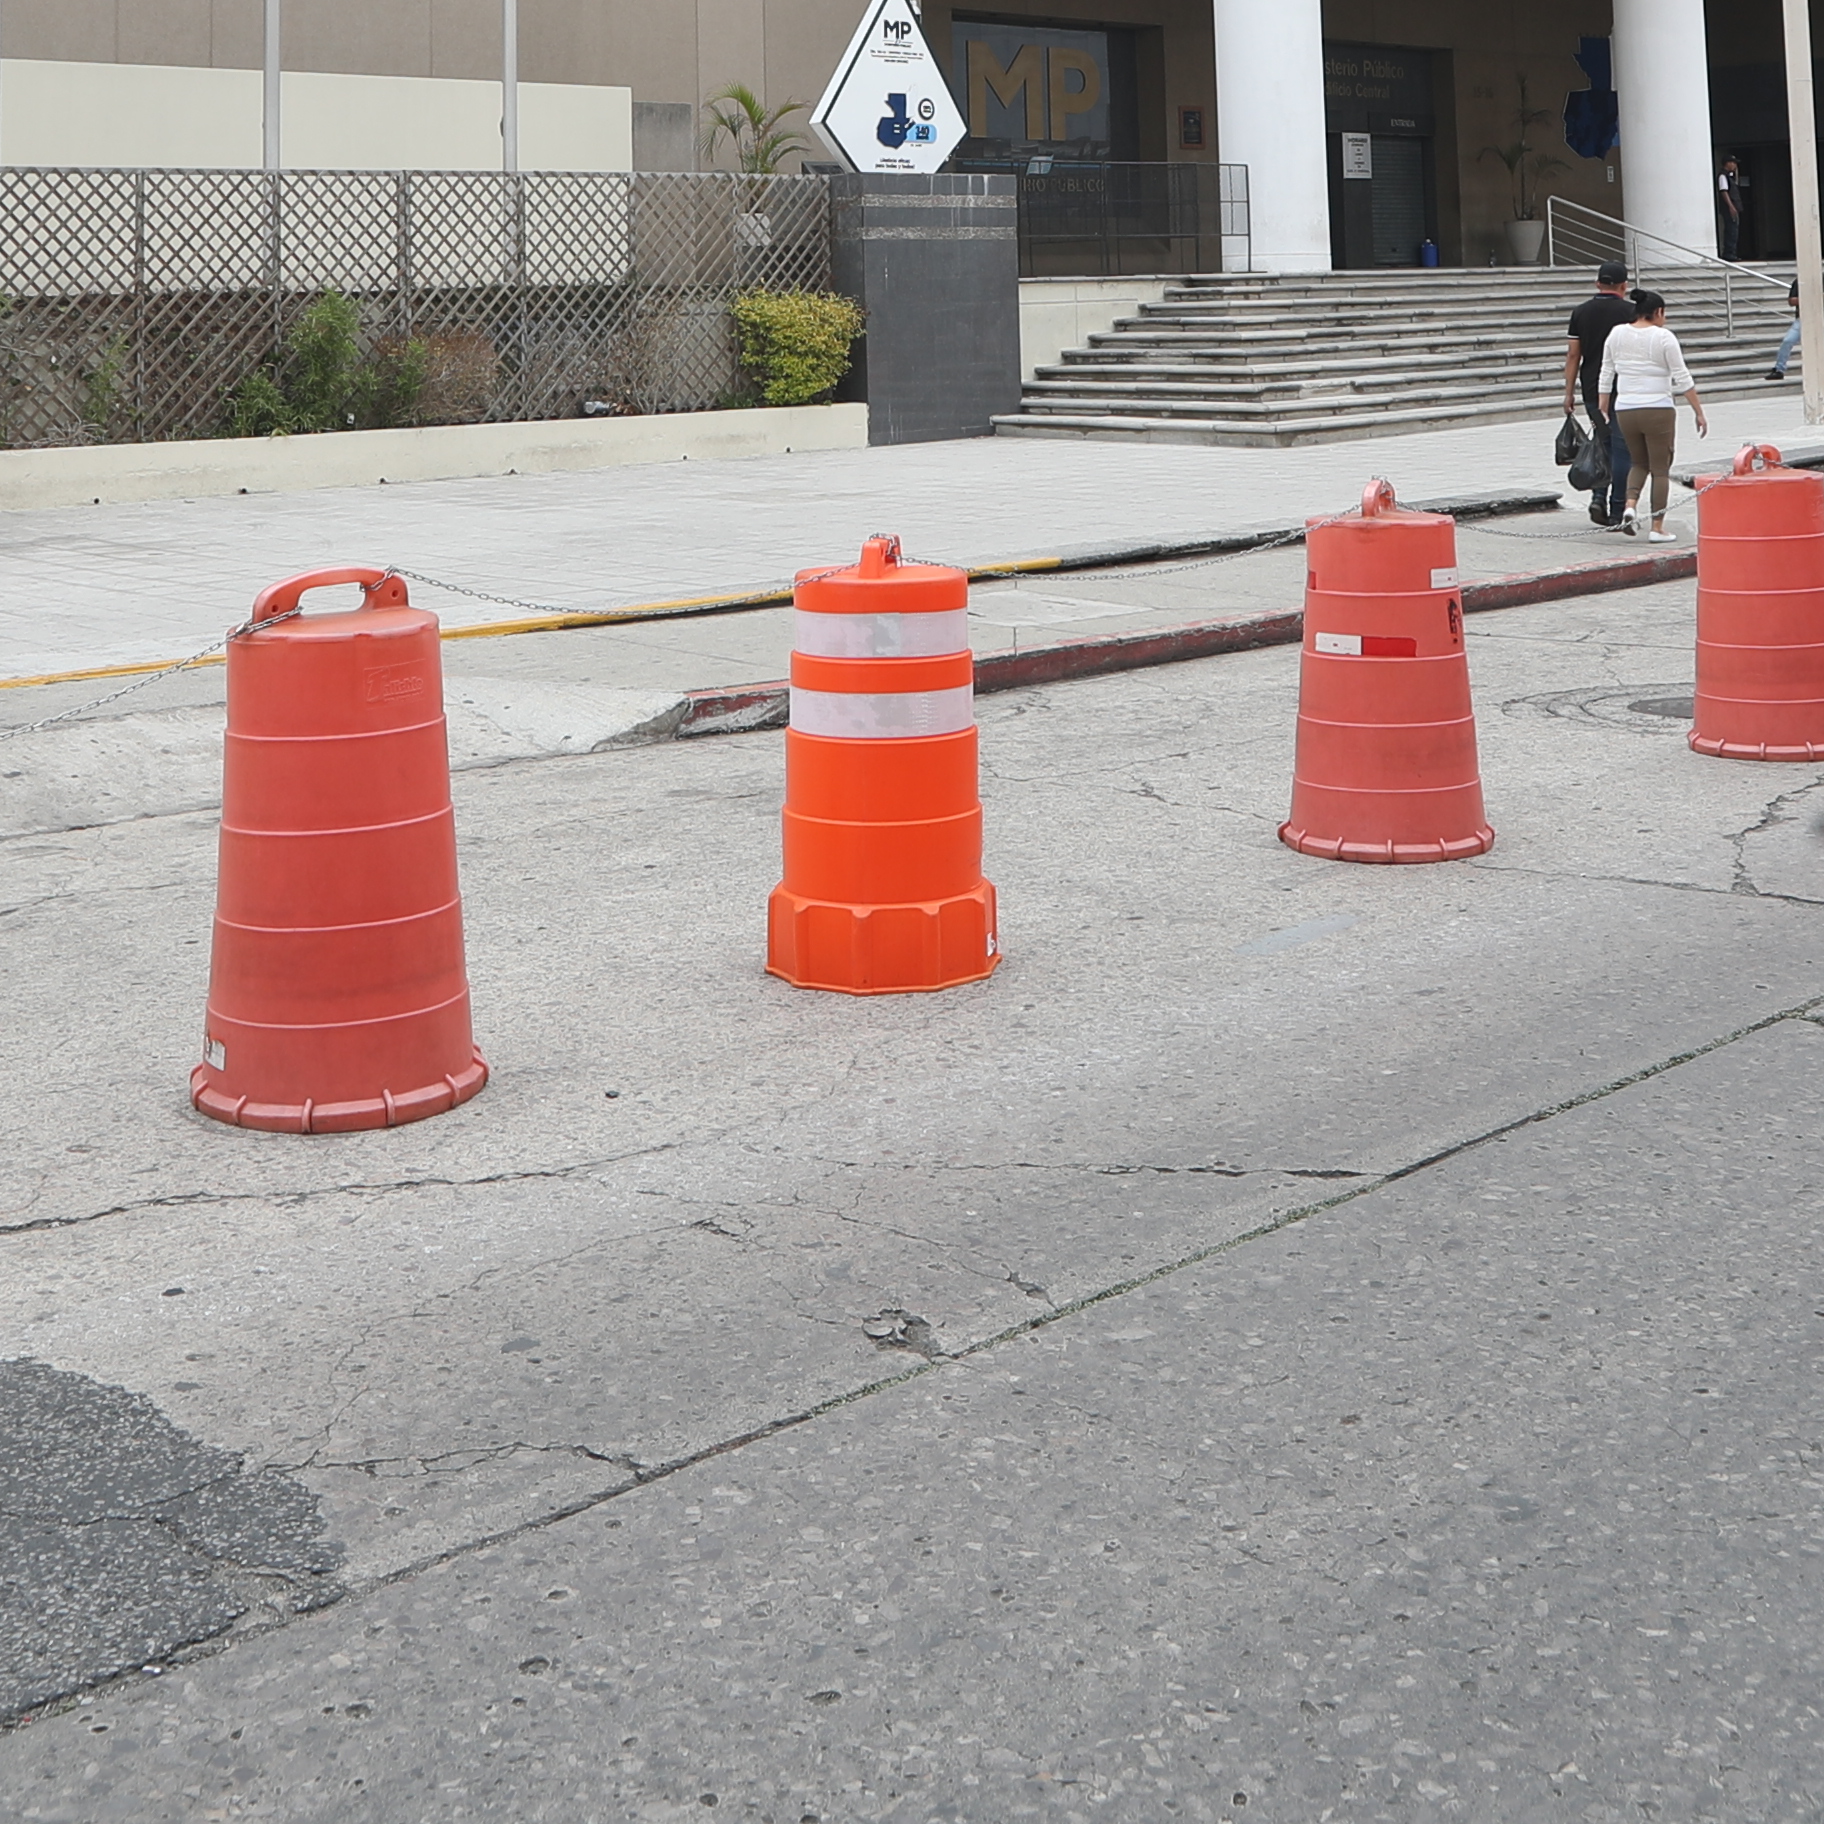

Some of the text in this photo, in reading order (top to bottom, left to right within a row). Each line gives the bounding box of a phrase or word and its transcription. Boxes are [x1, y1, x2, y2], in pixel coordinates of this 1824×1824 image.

[883, 19, 912, 40] MP
[1363, 60, 1404, 79] Público
[966, 40, 1101, 141] MP
[1355, 82, 1390, 98] Central
